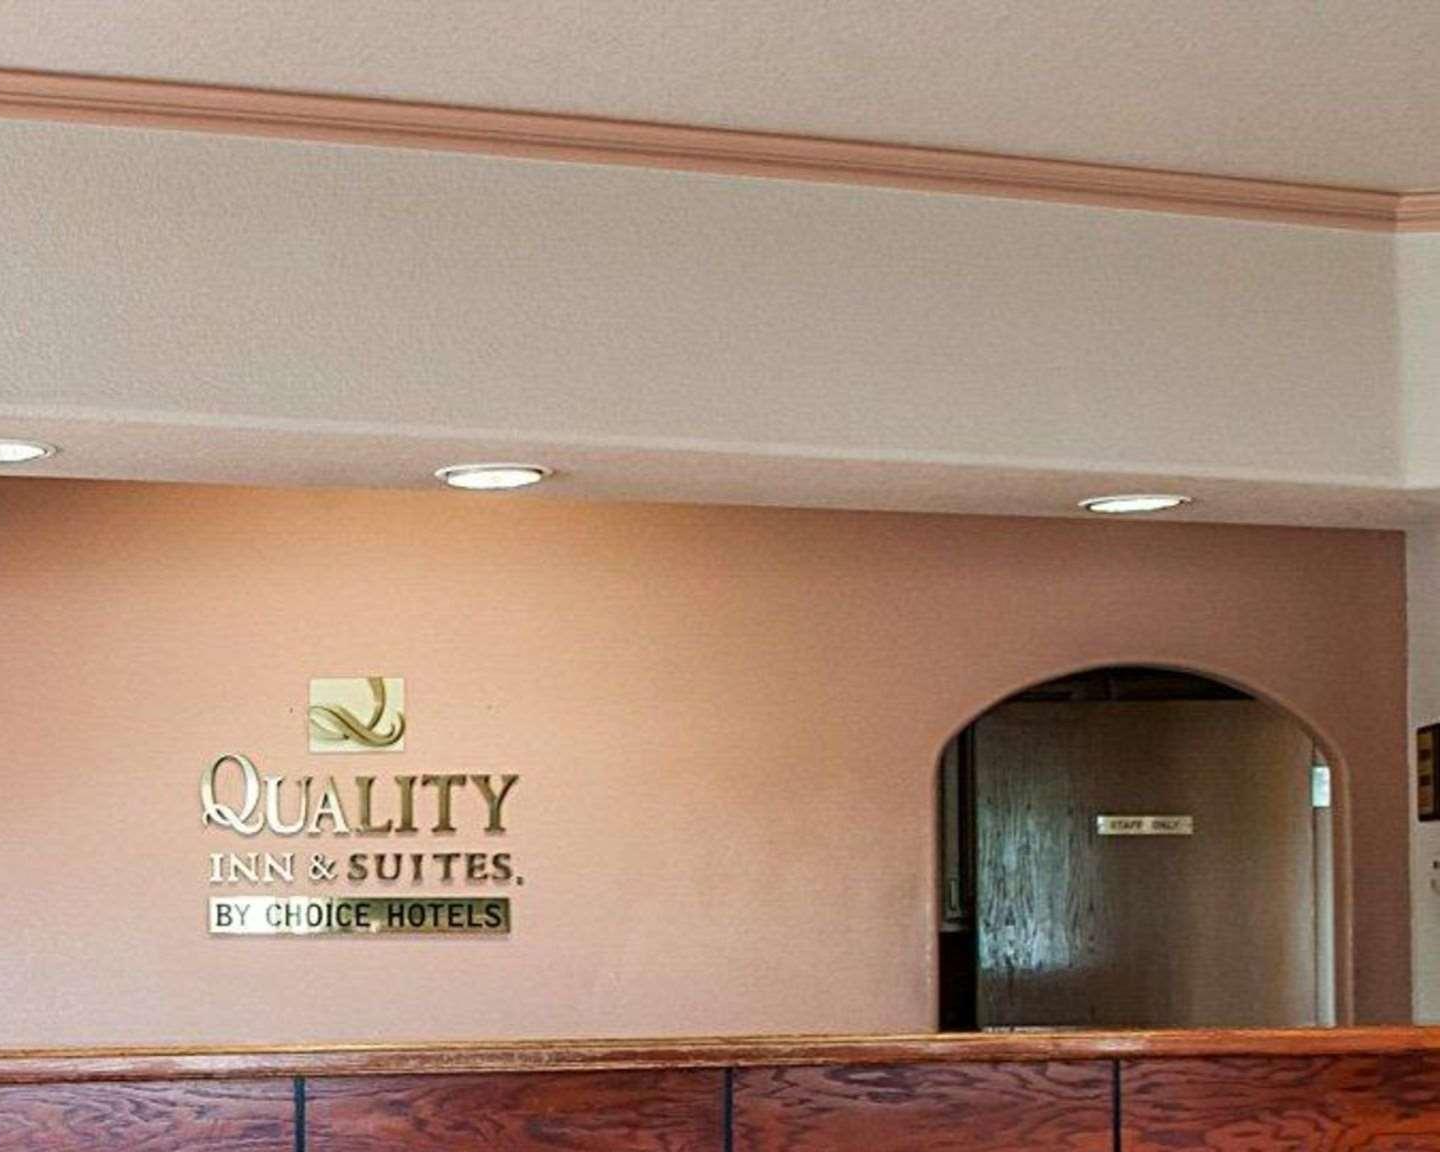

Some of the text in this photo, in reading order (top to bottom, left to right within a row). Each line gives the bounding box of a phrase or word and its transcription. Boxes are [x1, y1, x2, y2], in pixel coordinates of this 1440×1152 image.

[201, 752, 519, 836] QUALITY
[210, 852, 295, 884] INN
[309, 852, 338, 883] &
[215, 902, 502, 929] BY CHOICE HOTELS
